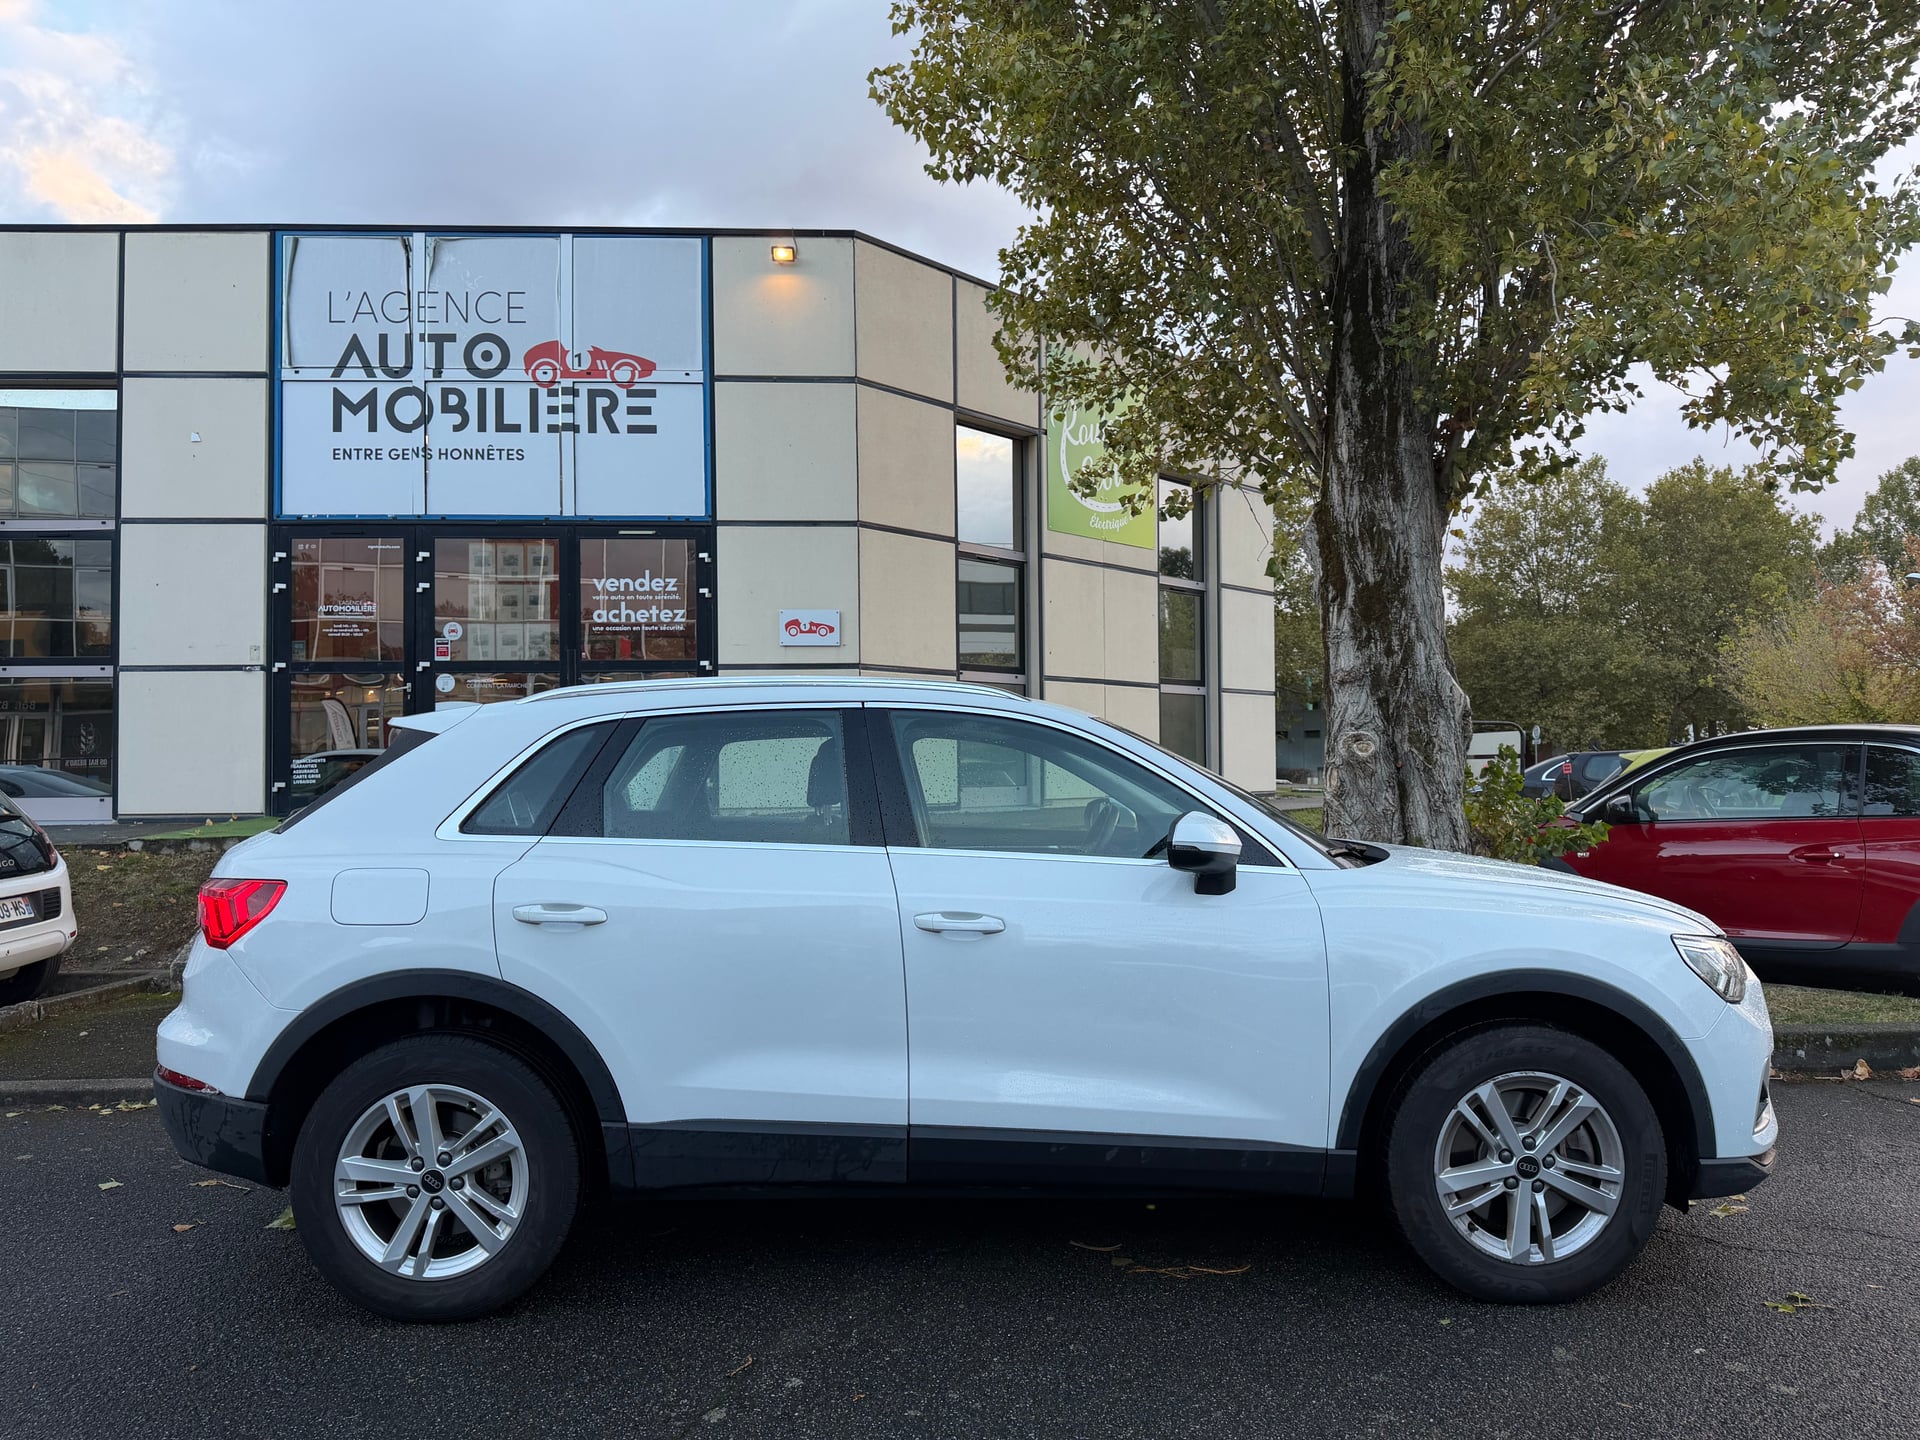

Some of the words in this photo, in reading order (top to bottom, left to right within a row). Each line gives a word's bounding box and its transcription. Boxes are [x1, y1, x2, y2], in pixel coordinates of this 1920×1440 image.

[328, 290, 527, 324] L'AGENCE
[330, 332, 511, 379] AUTO
[574, 352, 582, 368] 1
[332, 447, 384, 461] ENTRE
[388, 445, 433, 461] GENS
[438, 444, 526, 461] HONNÊTES
[592, 569, 678, 592] vendez
[592, 601, 687, 623] achetez
[659, 623, 686, 631] sécurité.
